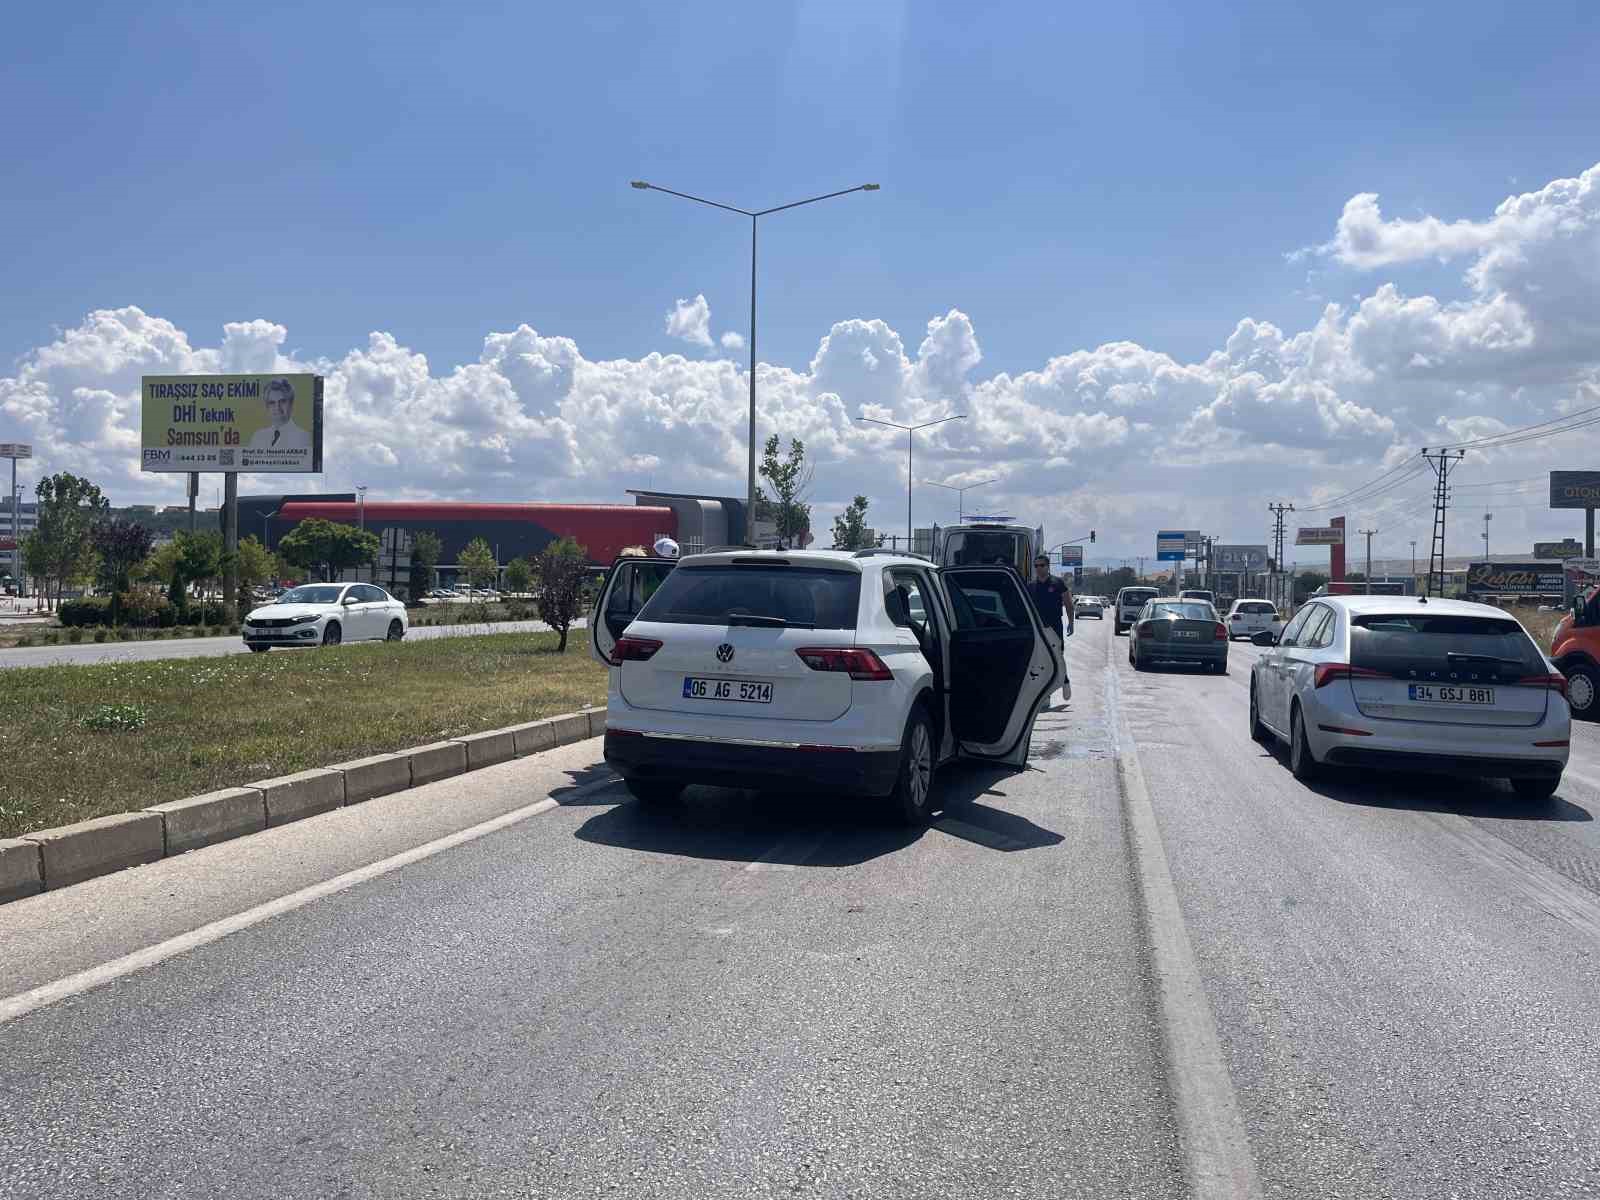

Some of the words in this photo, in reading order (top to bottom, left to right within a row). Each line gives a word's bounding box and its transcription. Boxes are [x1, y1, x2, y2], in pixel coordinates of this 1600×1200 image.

[149, 383, 198, 401] TIRAŞSIZ
[201, 383, 225, 400] SAÇ
[227, 379, 260, 397] EKİMİ
[174, 401, 196, 422] DHİ
[200, 408, 235, 423] Teknik
[168, 426, 240, 447] Samsun'da
[144, 449, 171, 460] FBM
[692, 681, 707, 696] 06
[715, 682, 731, 698] AG
[740, 683, 770, 701] 5214
[1417, 686, 1433, 699] 34
[1440, 687, 1463, 701] GSJ
